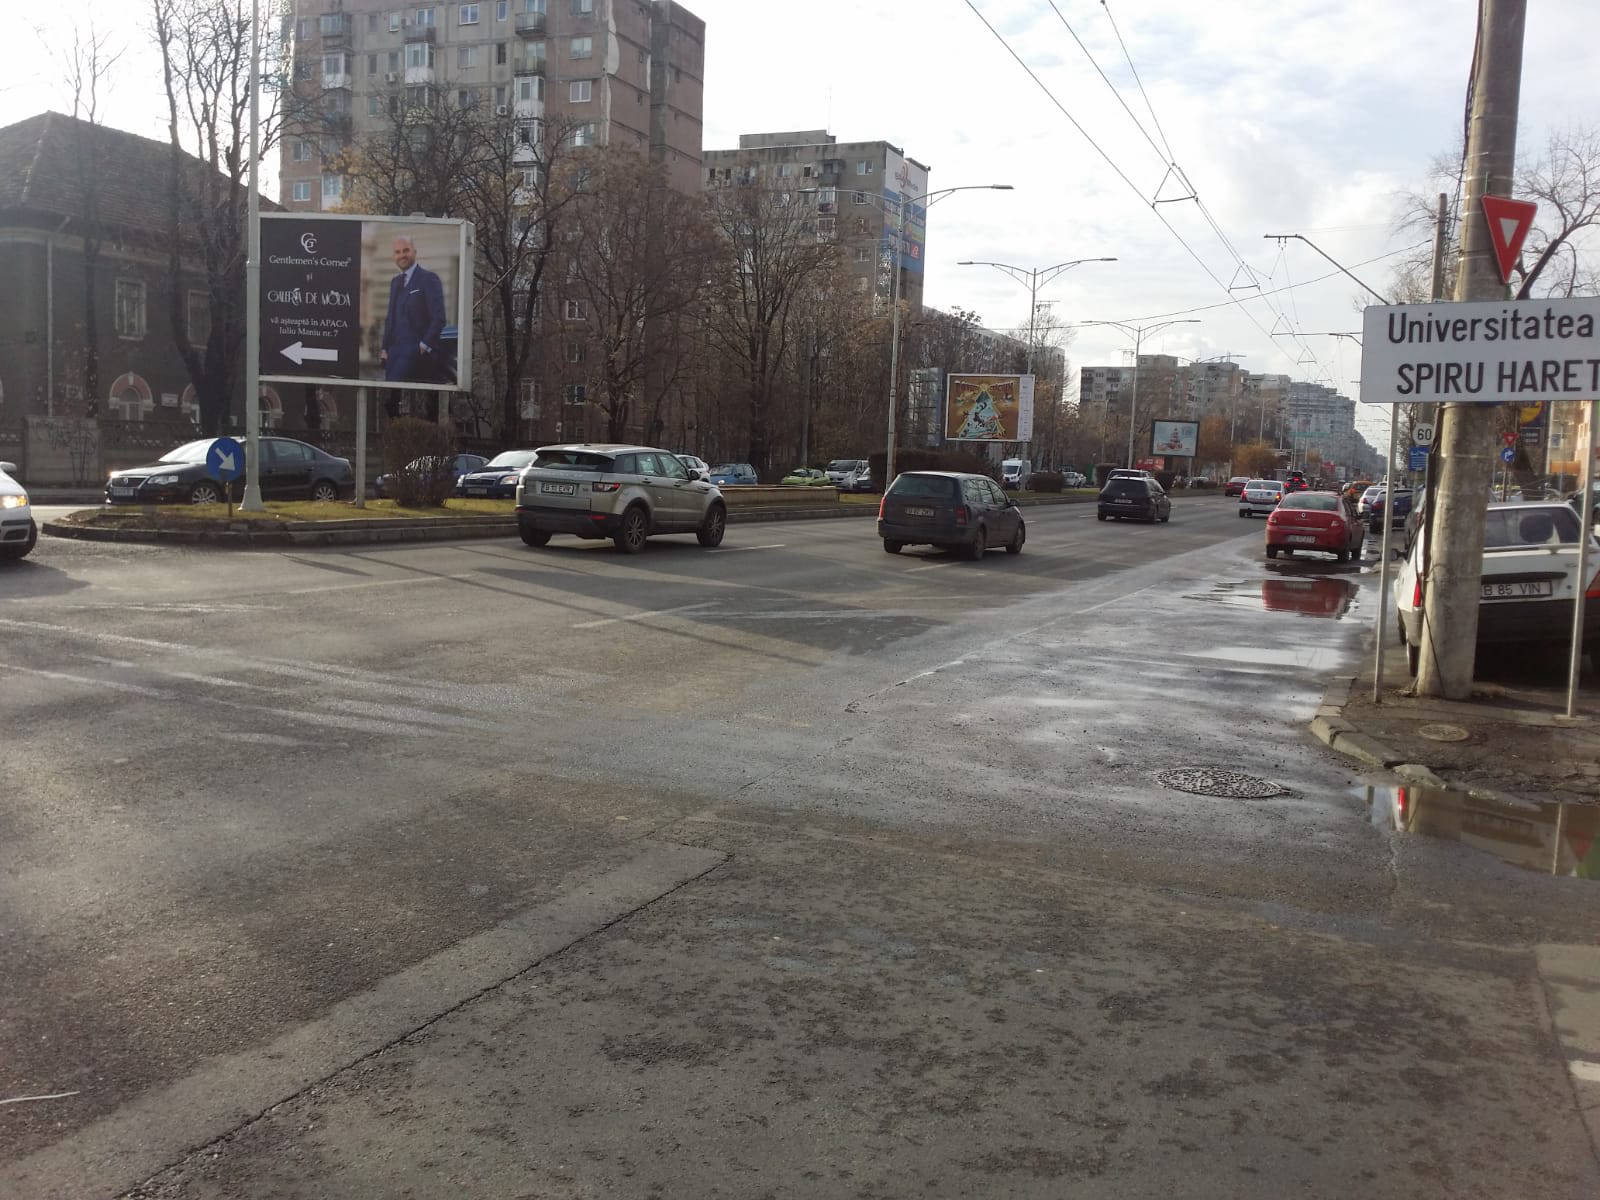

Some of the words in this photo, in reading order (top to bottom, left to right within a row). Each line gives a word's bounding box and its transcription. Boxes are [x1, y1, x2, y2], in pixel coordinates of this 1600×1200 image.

[269, 254, 318, 266] Gentlemen's
[305, 291, 318, 305] DE
[321, 289, 351, 307] MODA
[320, 319, 348, 329] APACA
[1388, 307, 1594, 344] Universitatea
[1396, 361, 1485, 395] SPIRU
[1498, 359, 1600, 393] HARET
[1417, 428, 1432, 441] 60
[1483, 584, 1493, 596] B
[1497, 583, 1513, 595] 85
[1519, 583, 1541, 594] VIN
